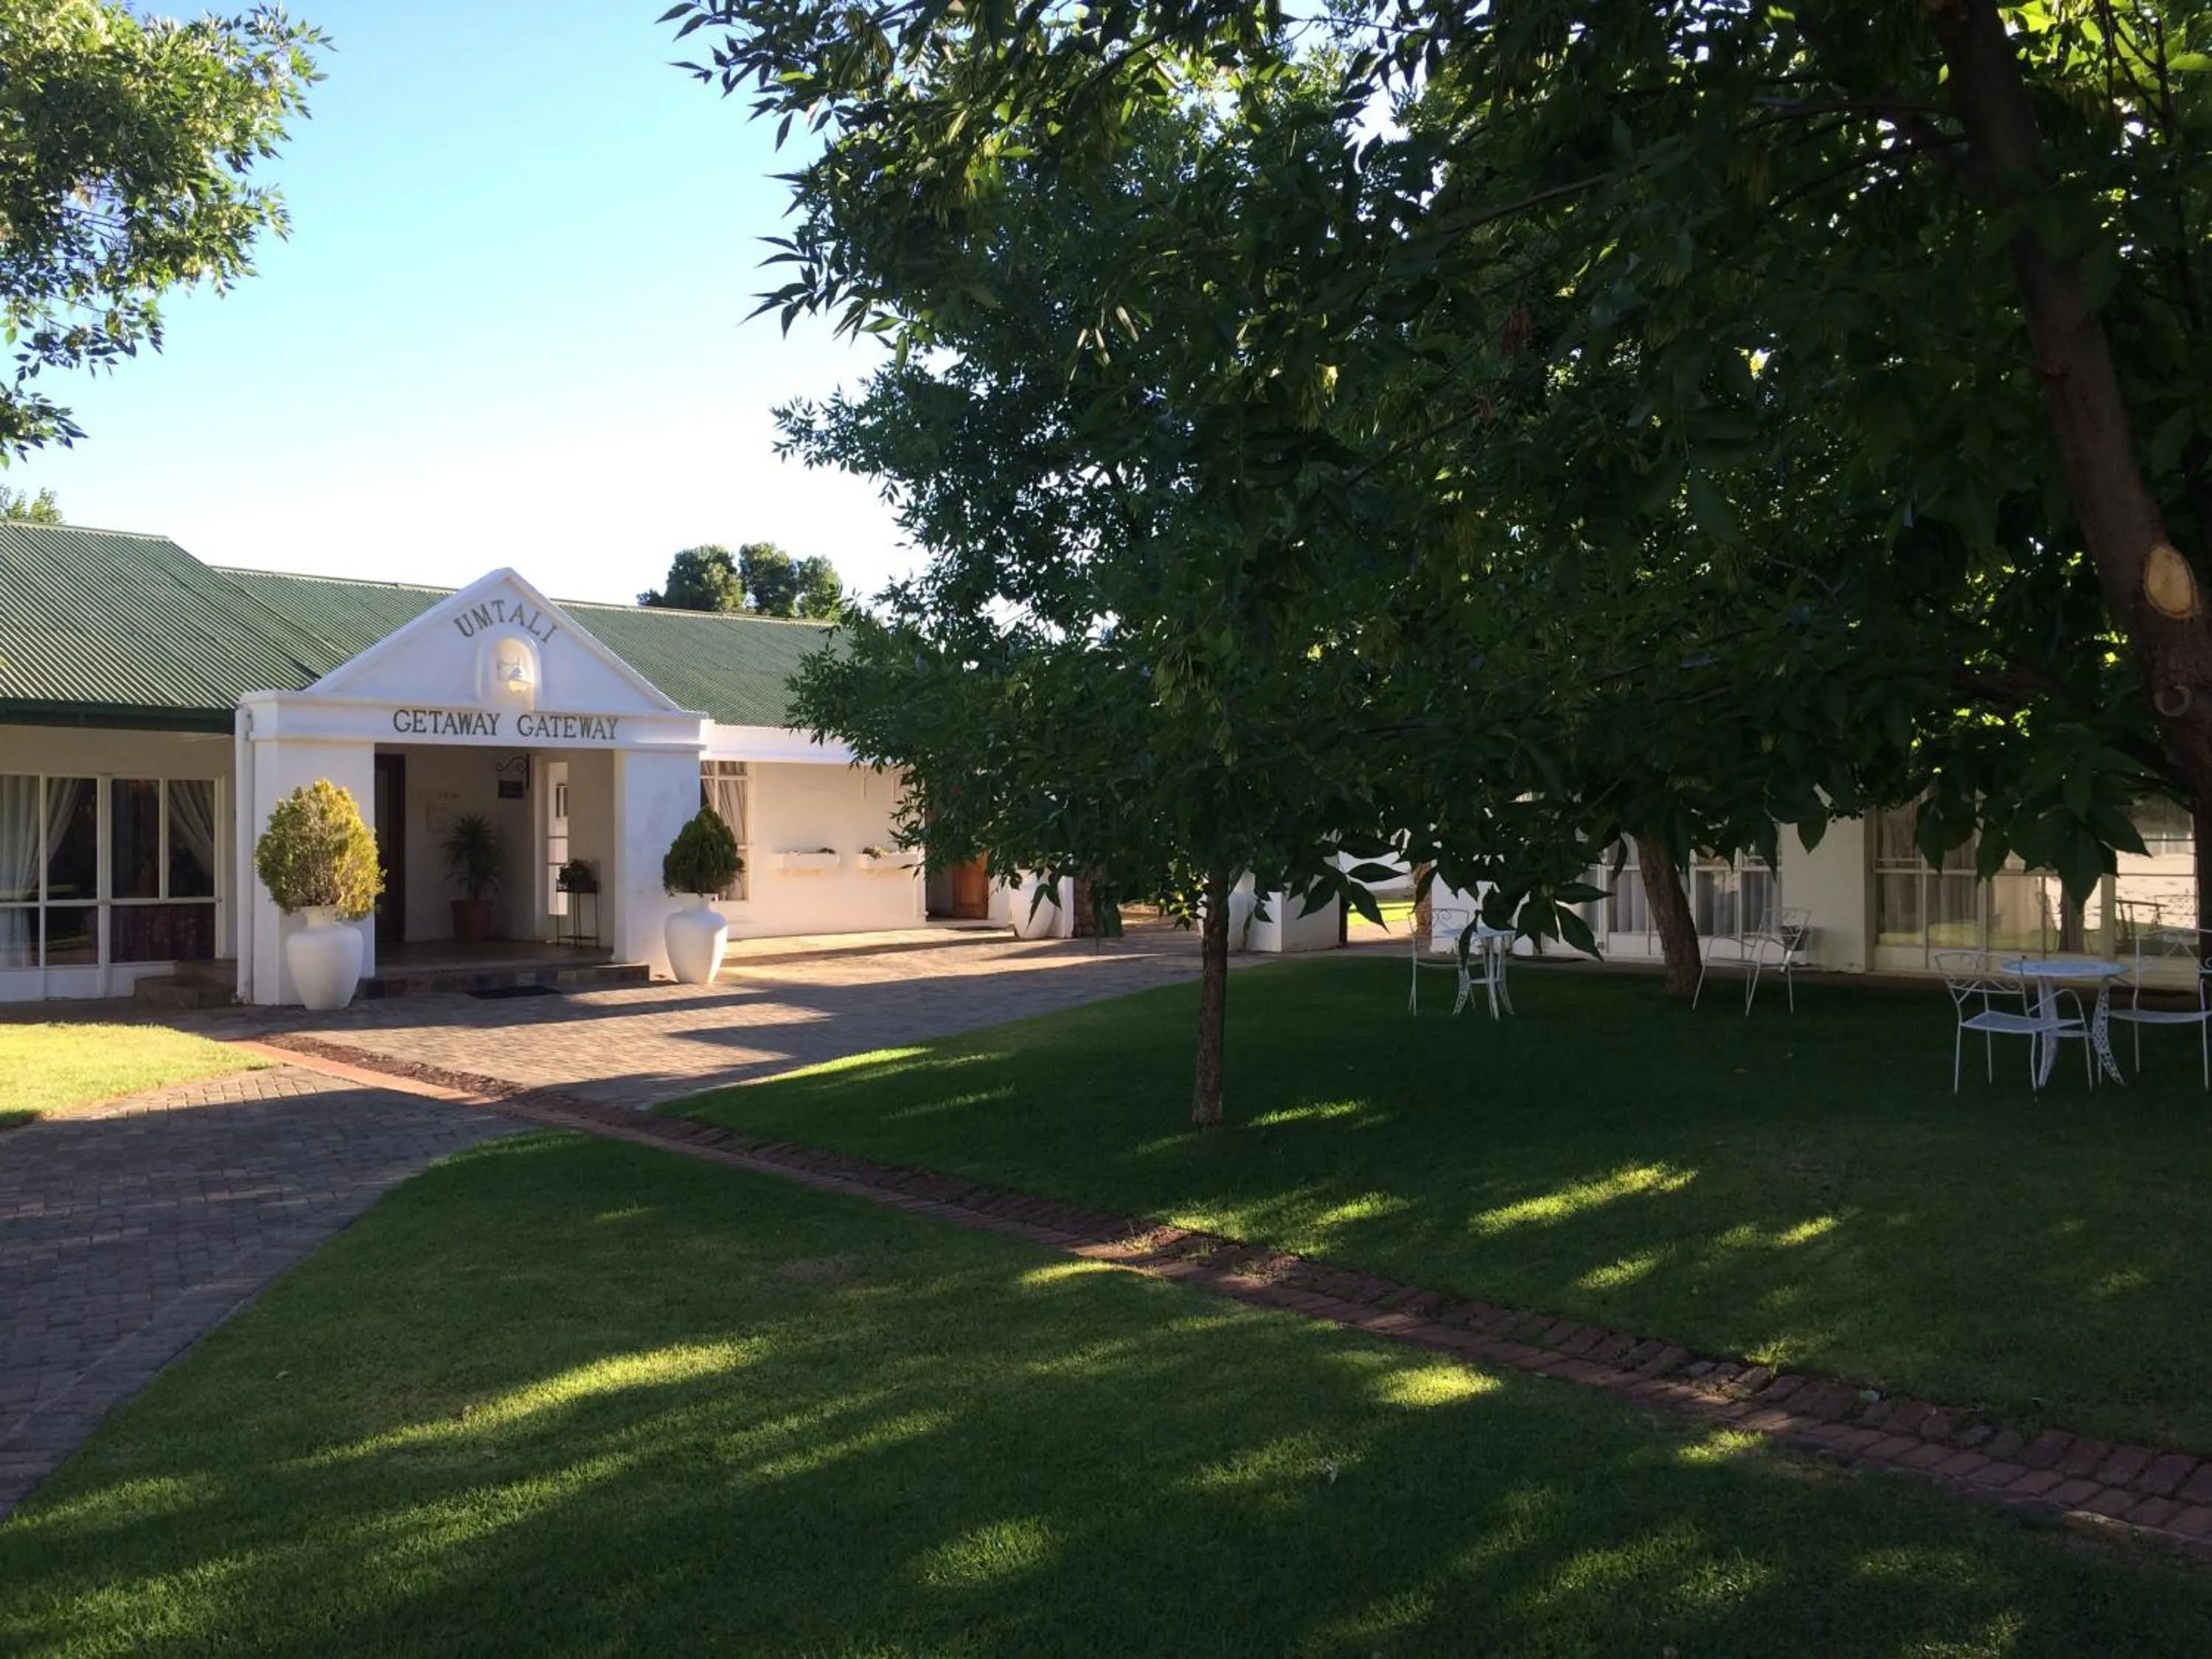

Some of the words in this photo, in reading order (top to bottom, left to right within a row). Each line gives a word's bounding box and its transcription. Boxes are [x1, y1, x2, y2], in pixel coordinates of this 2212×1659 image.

[453, 599, 558, 644] UMTALI
[392, 709, 501, 736] GETAWAY
[517, 714, 619, 740] GATEWAY
